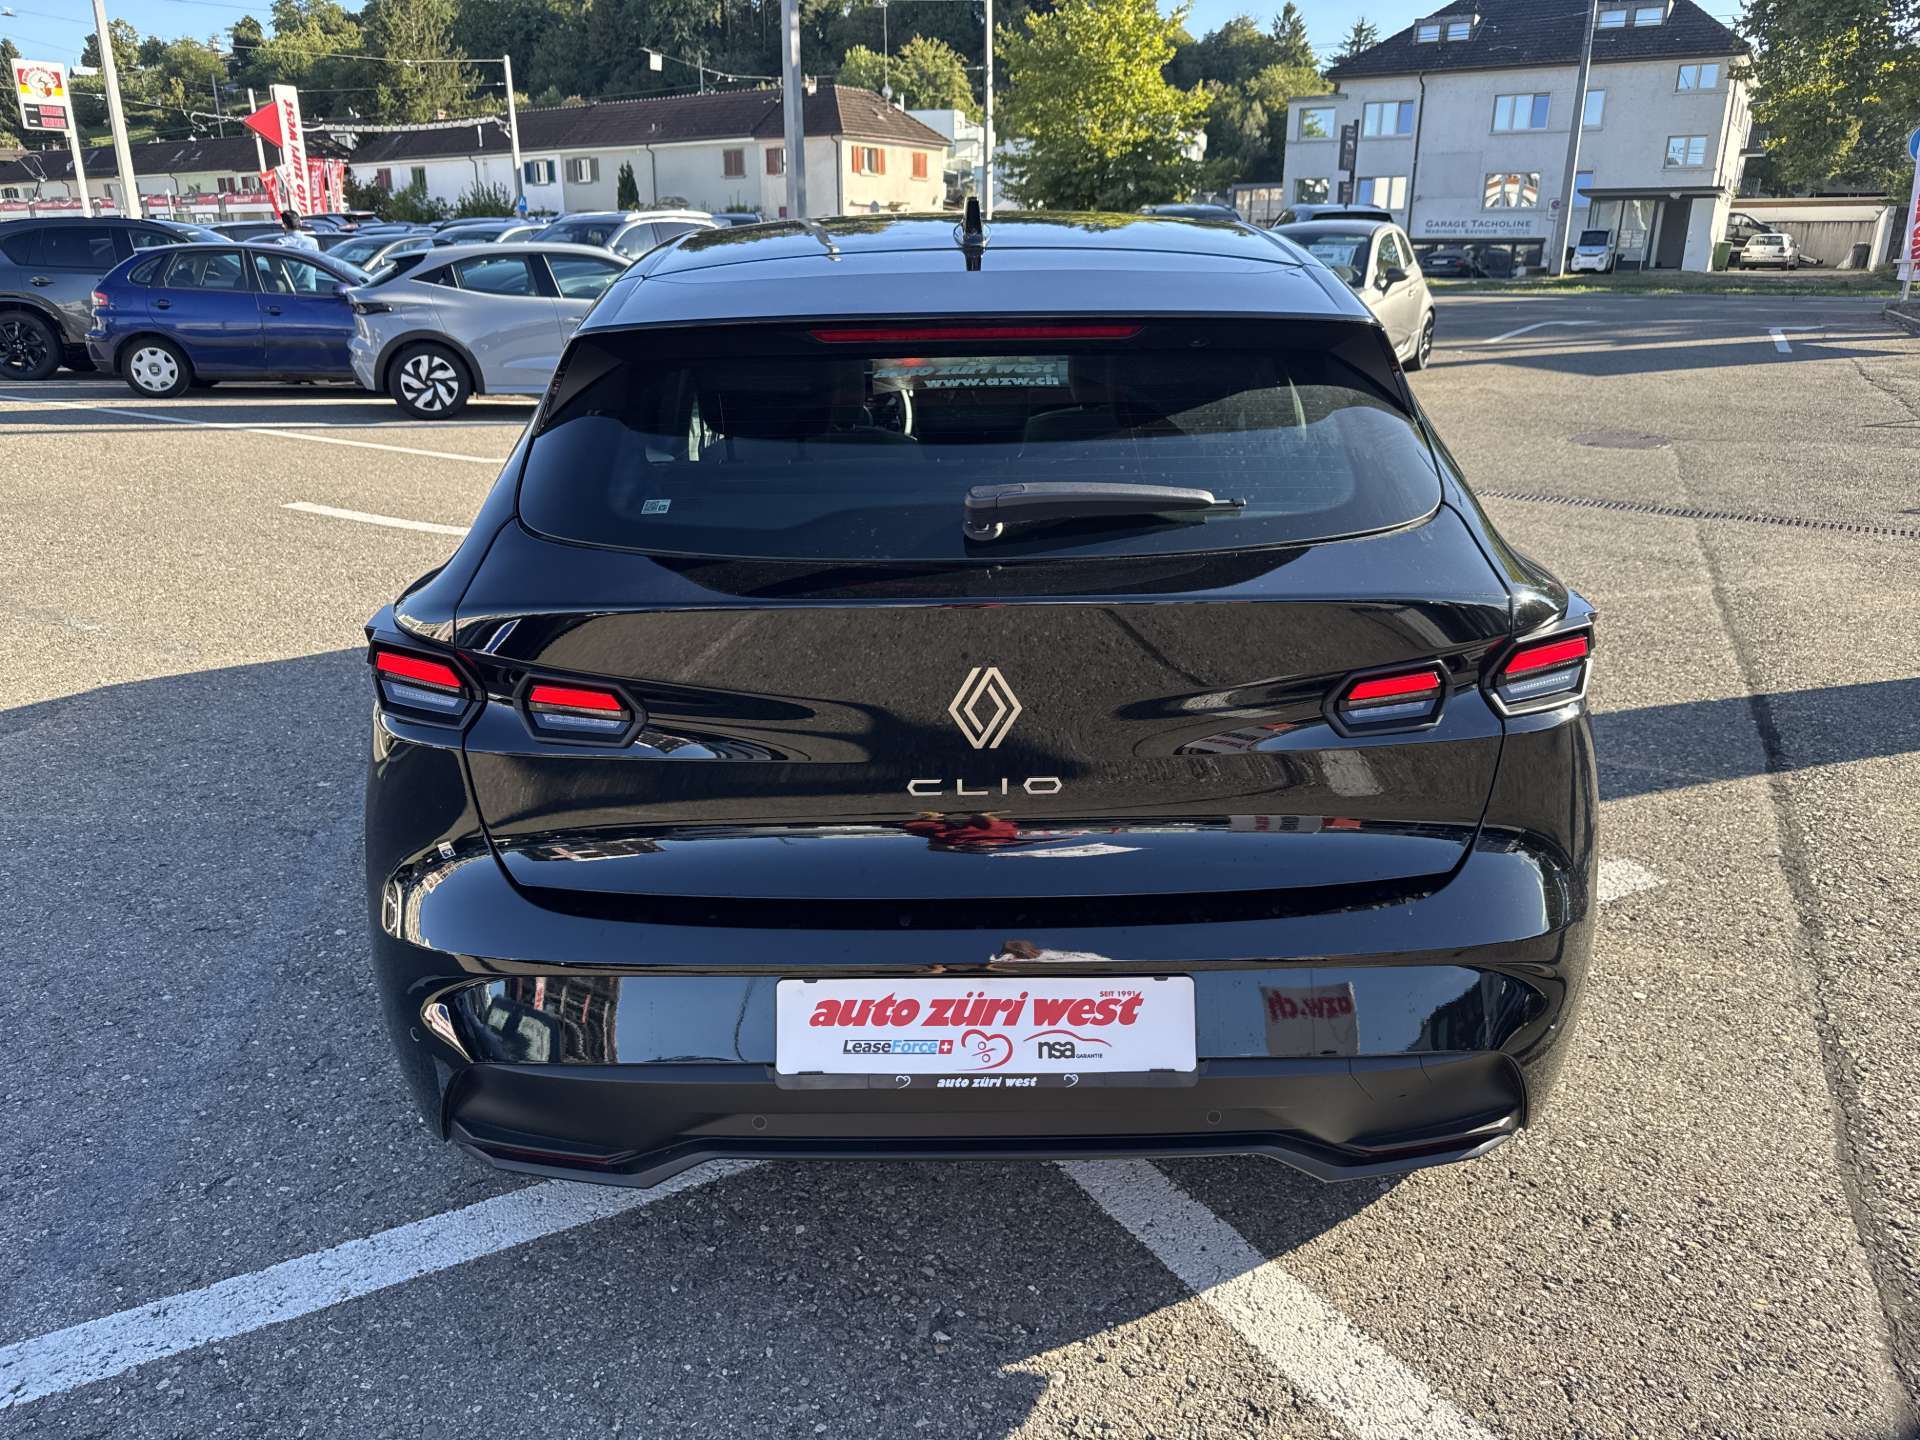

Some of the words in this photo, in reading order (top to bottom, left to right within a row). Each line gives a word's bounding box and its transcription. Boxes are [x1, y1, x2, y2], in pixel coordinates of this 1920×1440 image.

[283, 98, 299, 142] west
[1424, 219, 1468, 228] GARAGE
[1470, 219, 1532, 228] TACHOLINE
[923, 373, 1059, 389] www.azw.ch
[906, 776, 1063, 797] CLIO
[1099, 990, 1115, 998] SEIT
[1117, 990, 1137, 998] 1991
[809, 991, 921, 1027] auto
[920, 991, 1029, 1027] züri
[1033, 991, 1145, 1027] west
[842, 1039, 938, 1054] LeaseForce
[1037, 1040, 1076, 1059] nsa
[936, 1077, 969, 1088] auto
[971, 1075, 1003, 1088] züri
[1004, 1076, 1038, 1087] west
